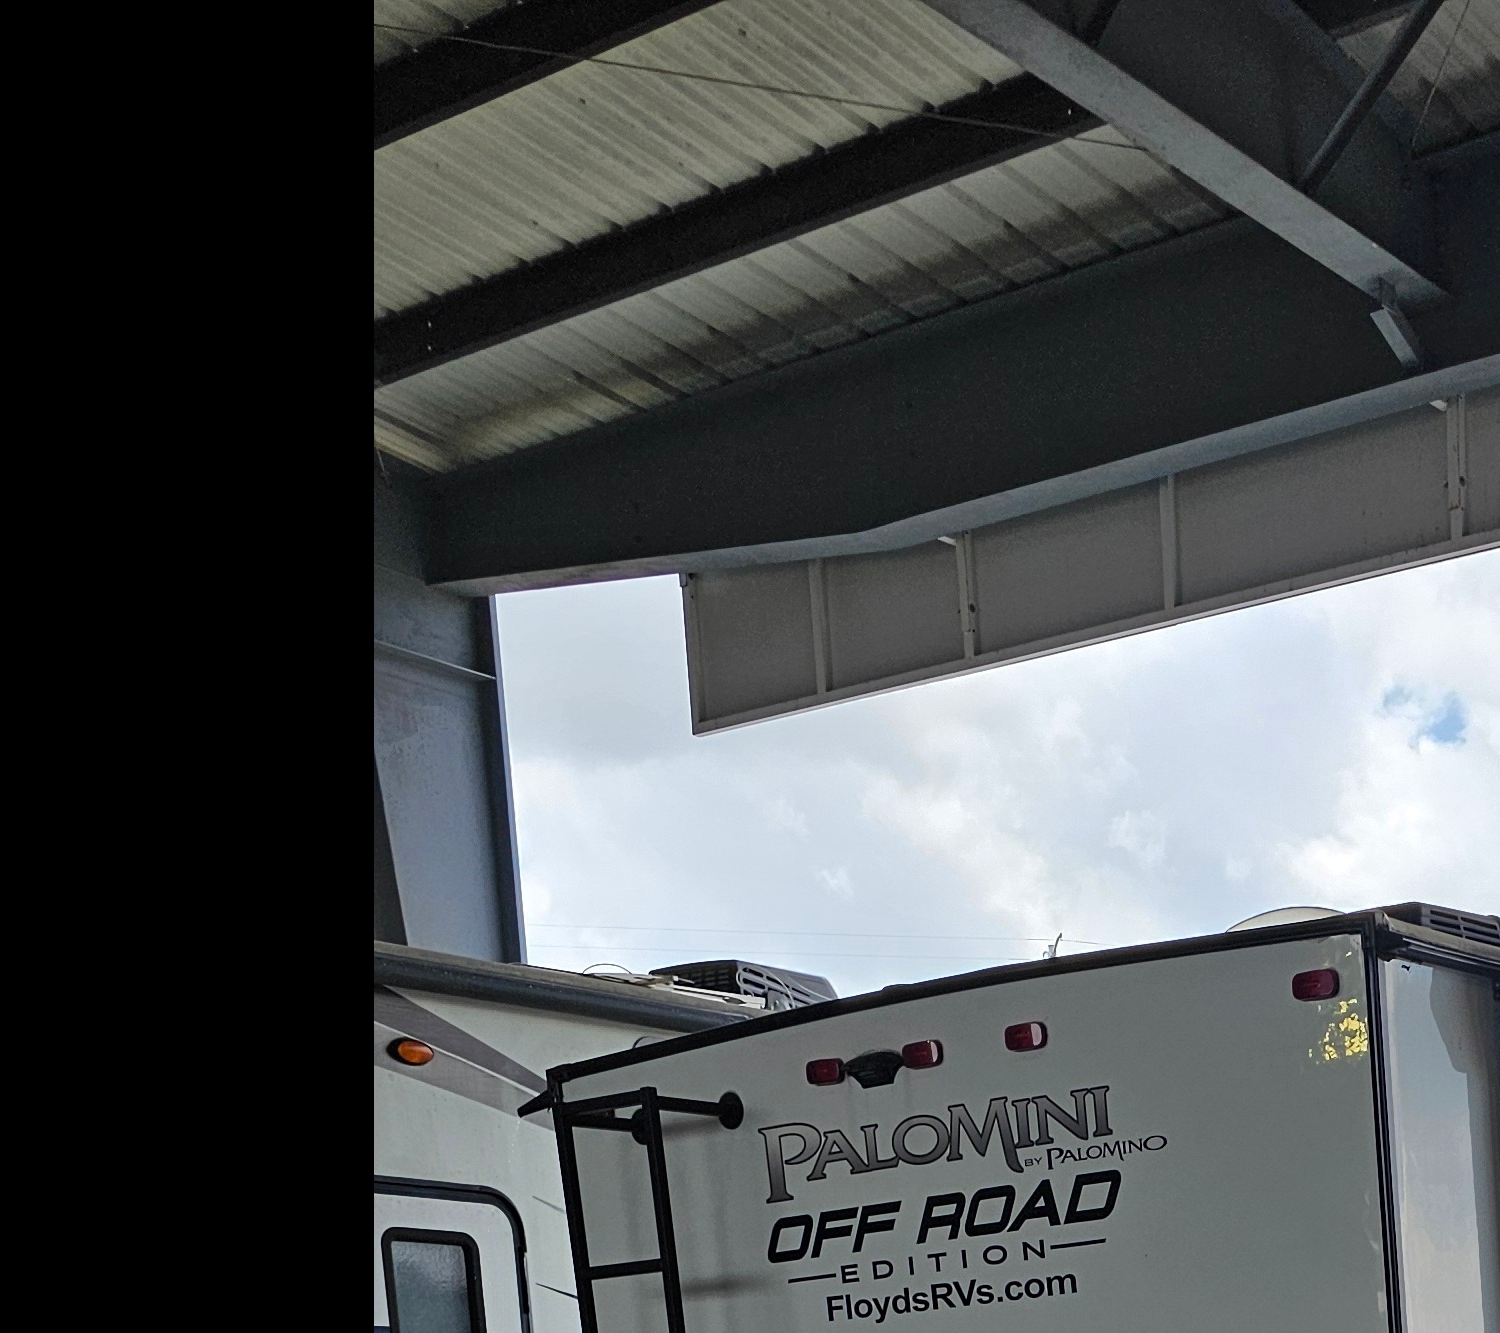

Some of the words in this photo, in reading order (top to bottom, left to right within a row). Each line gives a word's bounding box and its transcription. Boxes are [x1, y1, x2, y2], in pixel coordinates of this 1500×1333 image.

[757, 1084, 1114, 1204] PALOMINI
[1024, 1157, 1043, 1167] BY
[1046, 1135, 1168, 1170] PALOMINO
[768, 1200, 902, 1263] OFF
[916, 1169, 1121, 1245] ROAD
[840, 1239, 1046, 1284] EDITION
[826, 1272, 1078, 1323] FloydsRVs.com
